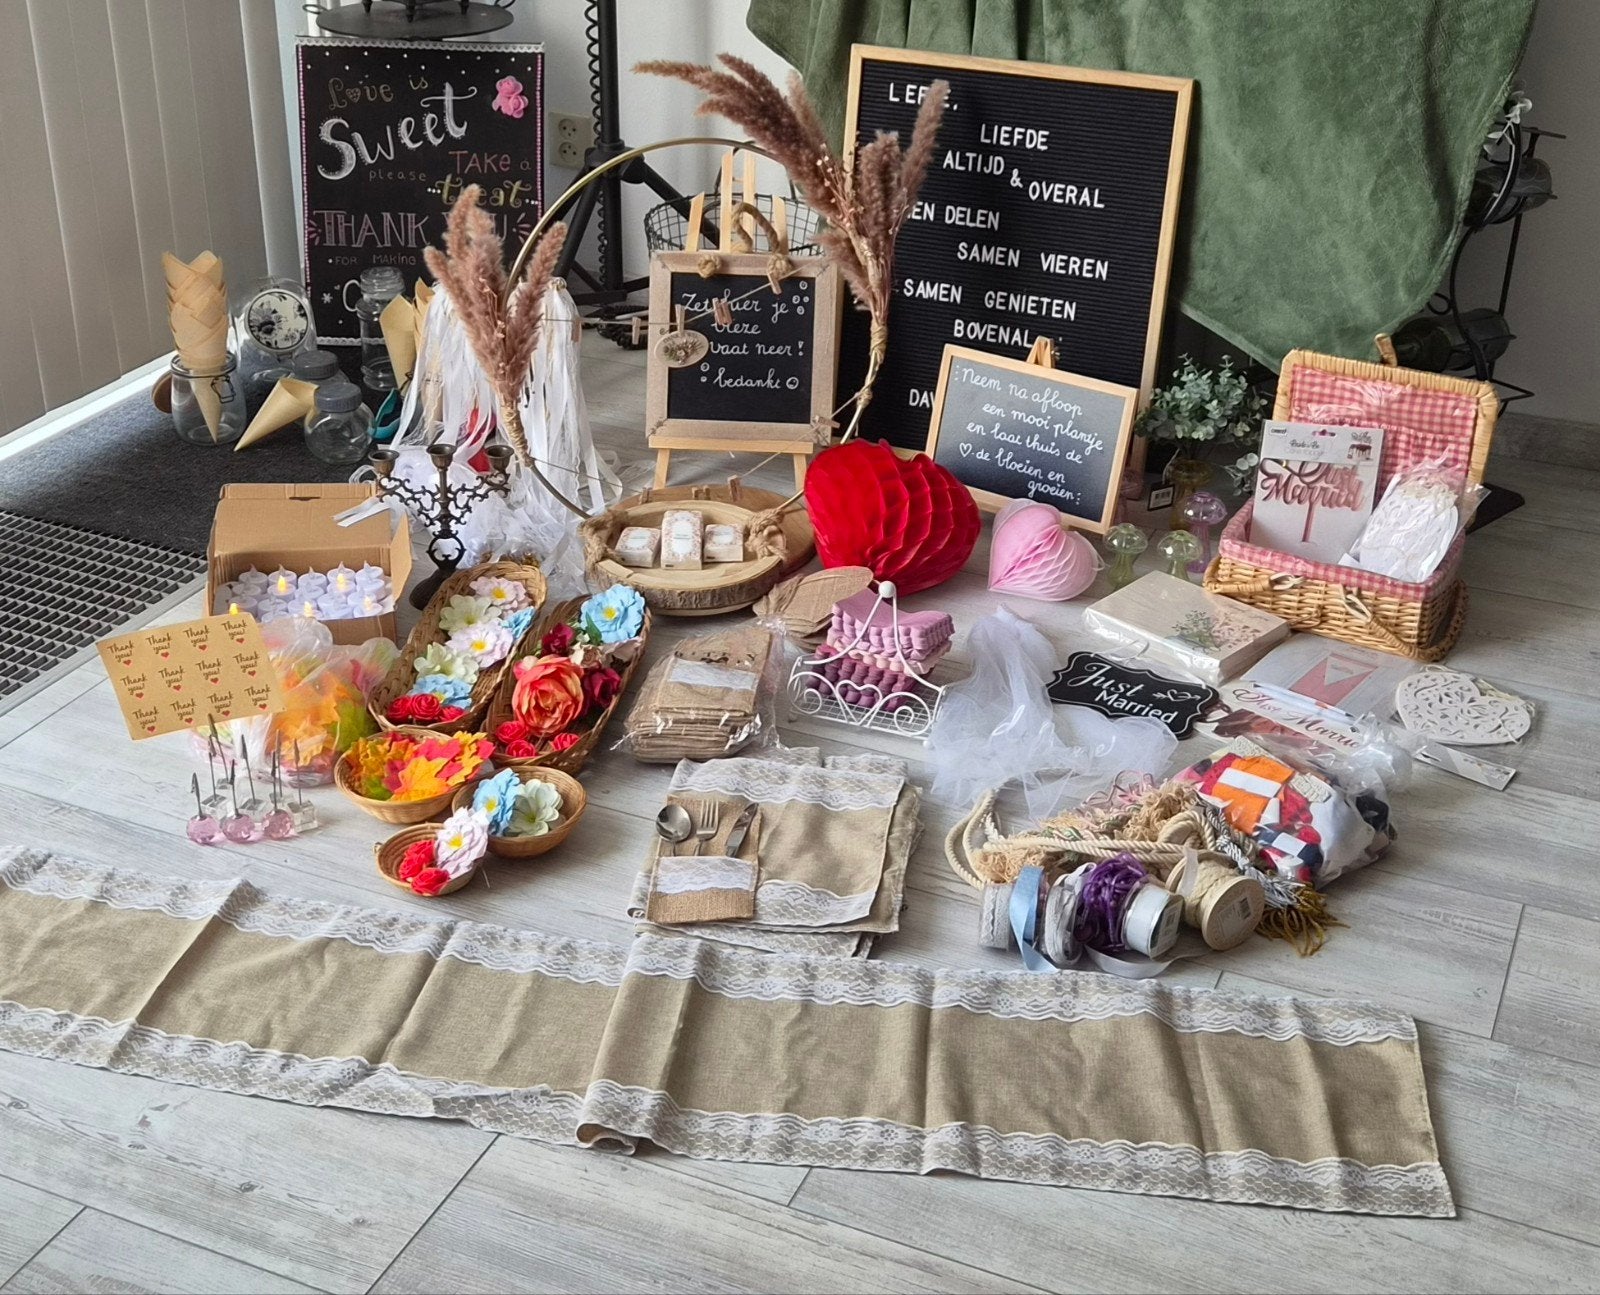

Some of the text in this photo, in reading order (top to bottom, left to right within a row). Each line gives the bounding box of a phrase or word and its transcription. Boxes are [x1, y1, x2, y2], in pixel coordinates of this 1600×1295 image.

[408, 74, 429, 90] is
[317, 82, 478, 180] Sweet
[980, 124, 1049, 151] LIEFDE
[520, 159, 532, 170] a
[369, 170, 427, 182] please
[943, 150, 1105, 209] ALTIJD & OVERAL
[435, 174, 532, 208] teat
[944, 205, 999, 231] DELEN
[313, 210, 431, 248] THANK
[335, 256, 358, 266] FOR
[957, 242, 1109, 281] SAMEN VIEREN
[682, 293, 713, 312] Zet
[771, 301, 789, 324] je
[903, 279, 1077, 322] SAMEN GENIETEN
[709, 341, 749, 355] vaat
[713, 367, 781, 390] bedankt
[962, 367, 1083, 419] Neem na afloop
[982, 402, 1005, 418] een
[1011, 409, 1051, 430] mooi
[966, 421, 986, 436] en
[1025, 434, 1060, 457] thuis
[1066, 450, 1083, 464] de
[995, 447, 1043, 480] bloeien
[1048, 470, 1065, 484] en
[183, 625, 210, 639] Thank
[221, 619, 248, 633] Thank
[145, 632, 172, 645] Thank
[107, 640, 135, 654] Thank
[195, 658, 223, 672] Thank
[233, 651, 260, 665] Thank
[120, 673, 148, 687] Thank
[158, 665, 185, 679] Thank
[1067, 662, 1144, 698] Just
[207, 691, 234, 705] Thank
[244, 684, 272, 698] Thank
[132, 706, 160, 720] Thank
[170, 698, 197, 713] Thank
[1095, 689, 1179, 724] Married
